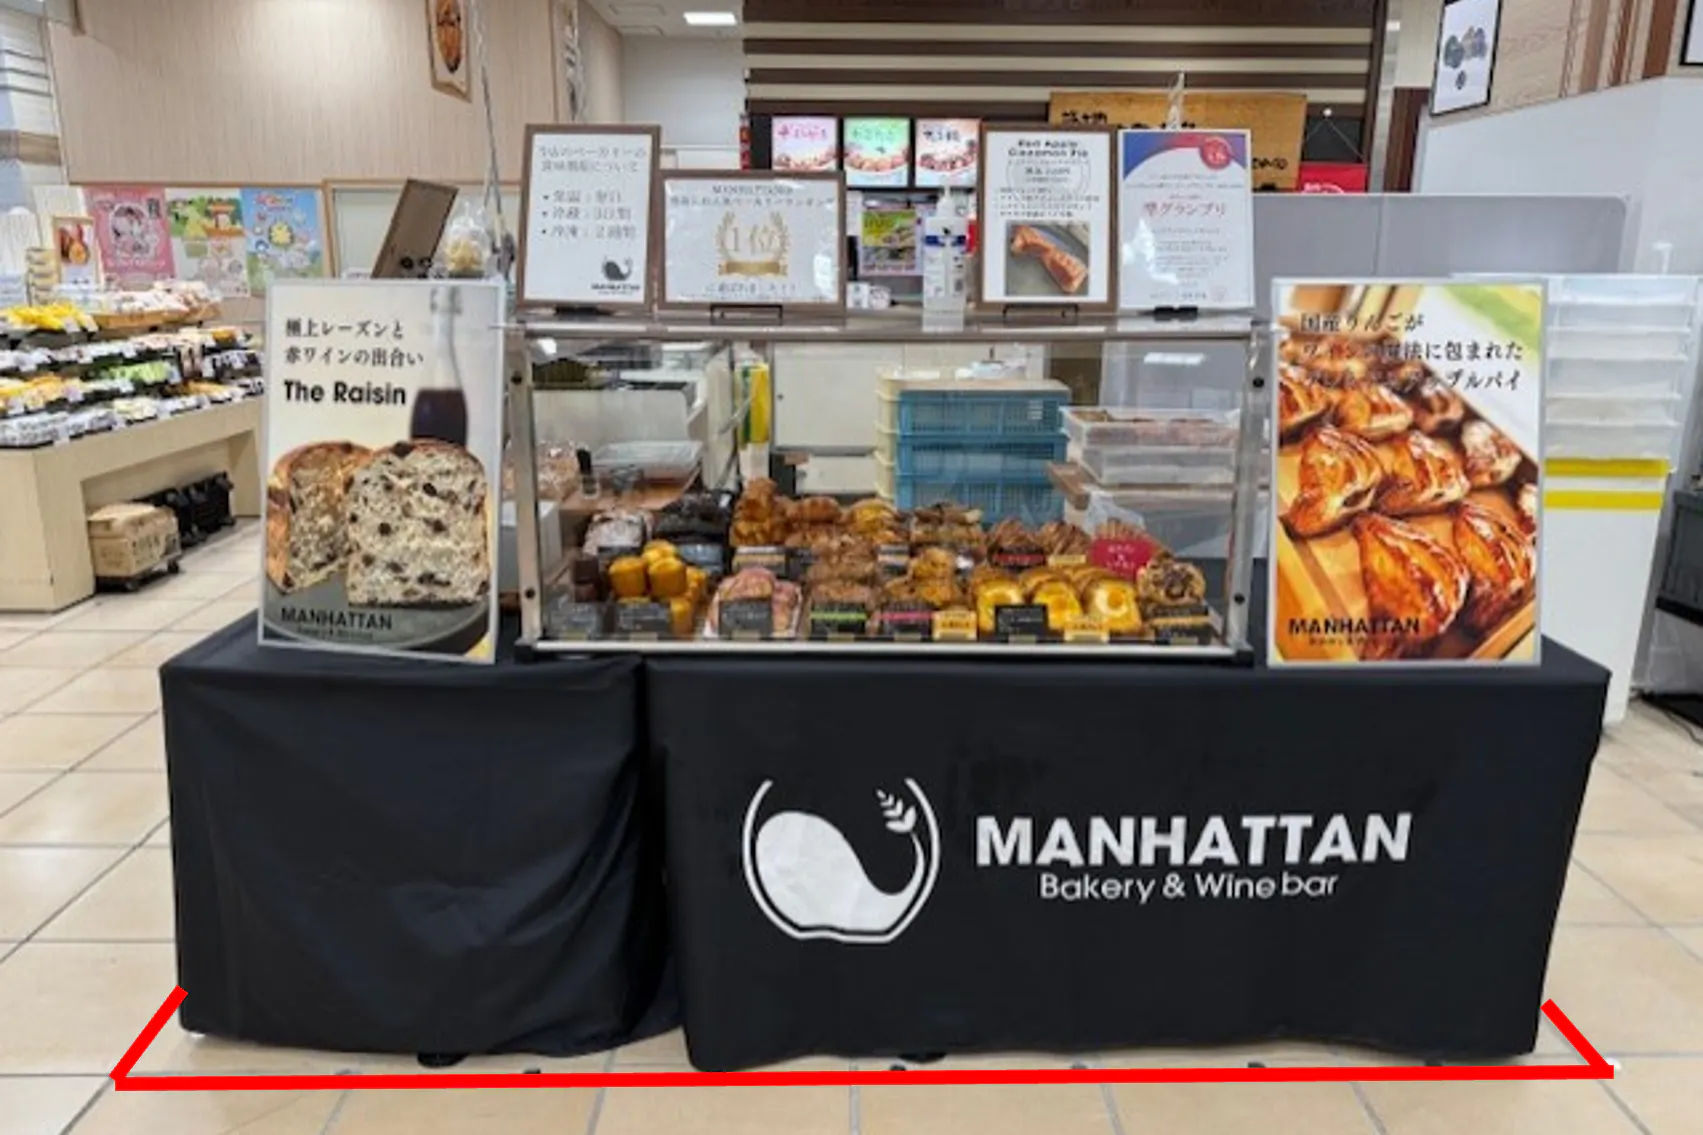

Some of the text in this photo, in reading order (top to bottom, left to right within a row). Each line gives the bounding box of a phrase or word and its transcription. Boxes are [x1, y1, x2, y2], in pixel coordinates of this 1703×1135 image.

[285, 318, 404, 338] 極上レーズンと
[1301, 312, 1425, 332] 国産りんごが
[283, 380, 406, 405] The Raisin
[281, 607, 392, 630] MANHATTAN
[1288, 617, 1420, 635] MANHATTAN
[976, 812, 1412, 867] MANHATTAN
[1040, 870, 1339, 903] Bakery & Wine bar
